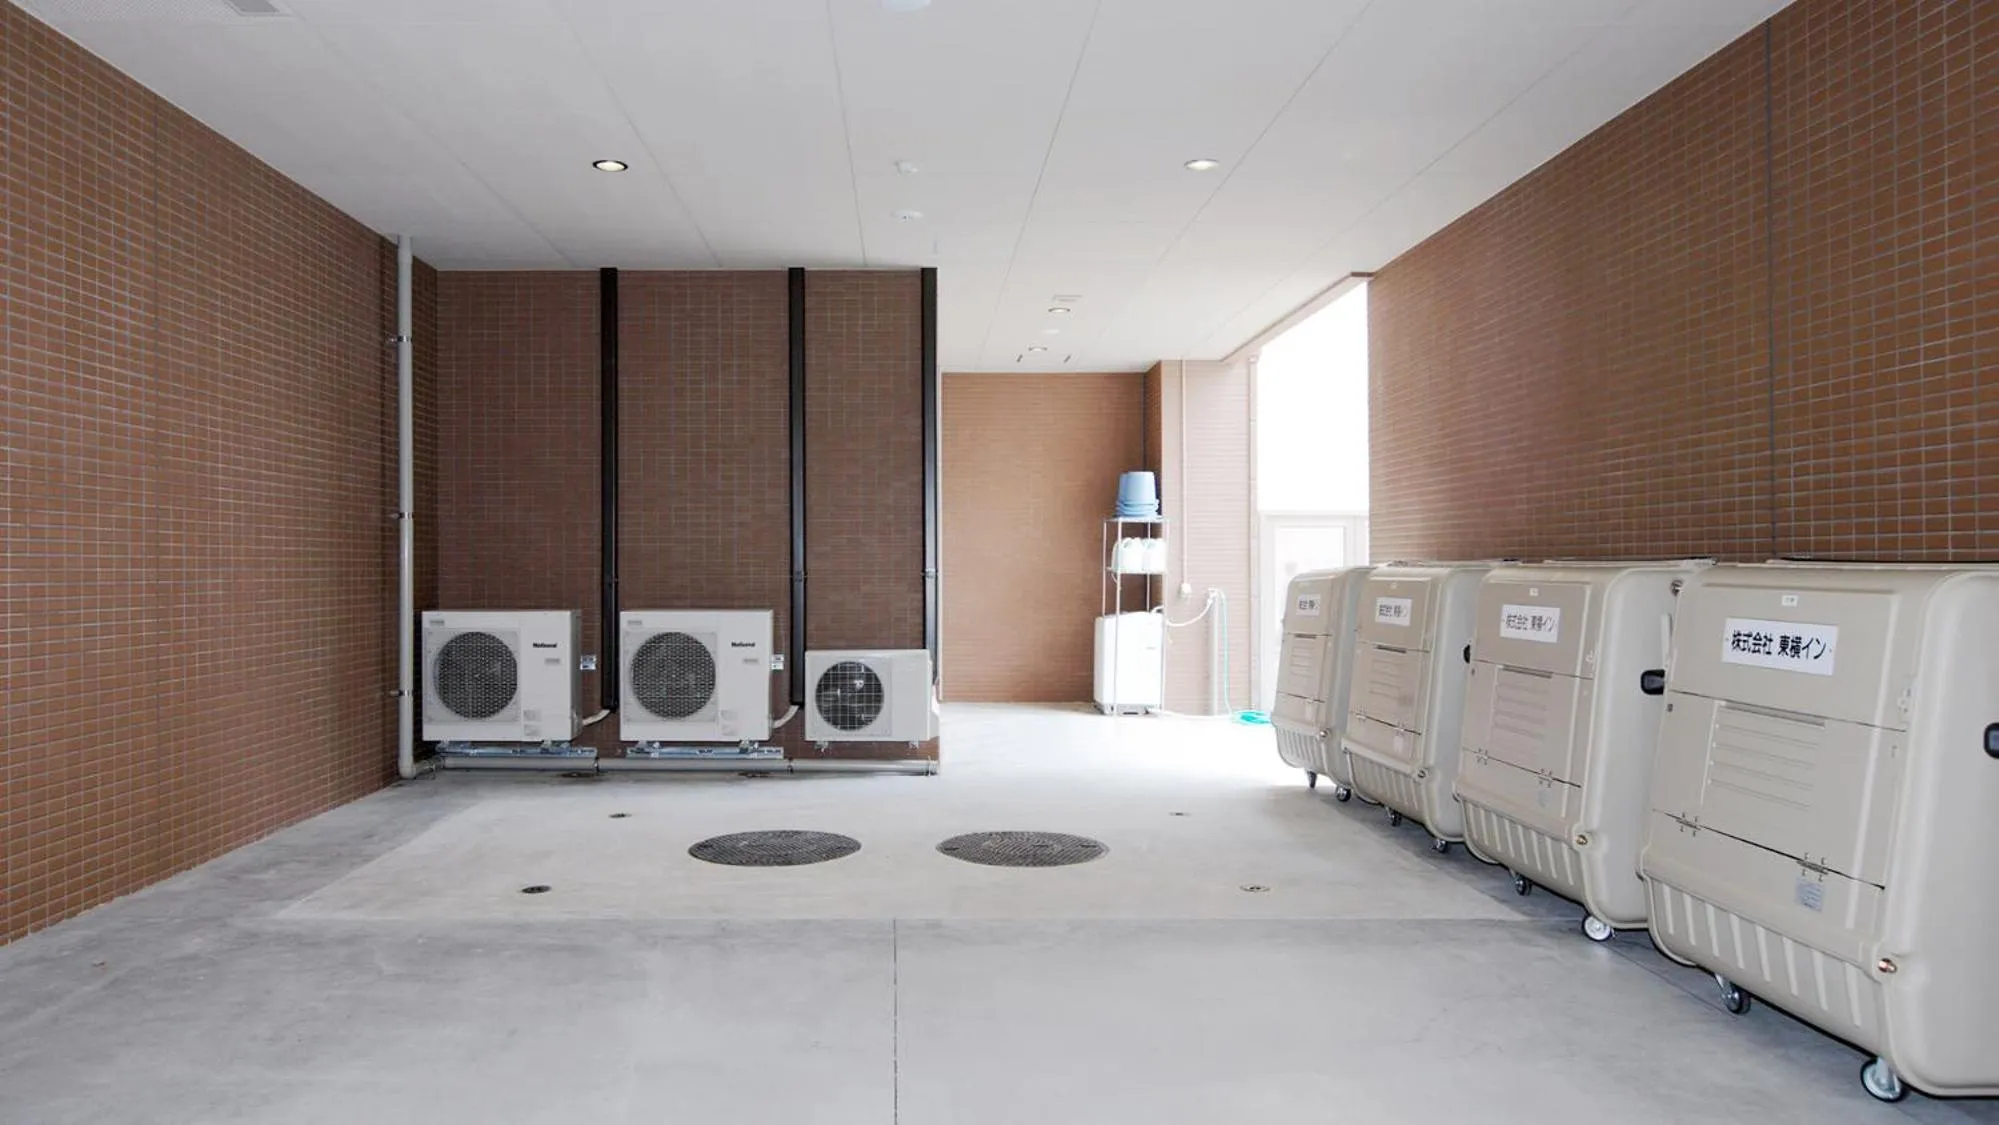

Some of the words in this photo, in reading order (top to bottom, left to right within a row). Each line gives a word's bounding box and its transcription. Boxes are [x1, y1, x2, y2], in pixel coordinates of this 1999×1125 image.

[1731, 630, 1773, 655] 株式会社
[1778, 634, 1826, 660] 東横イン
